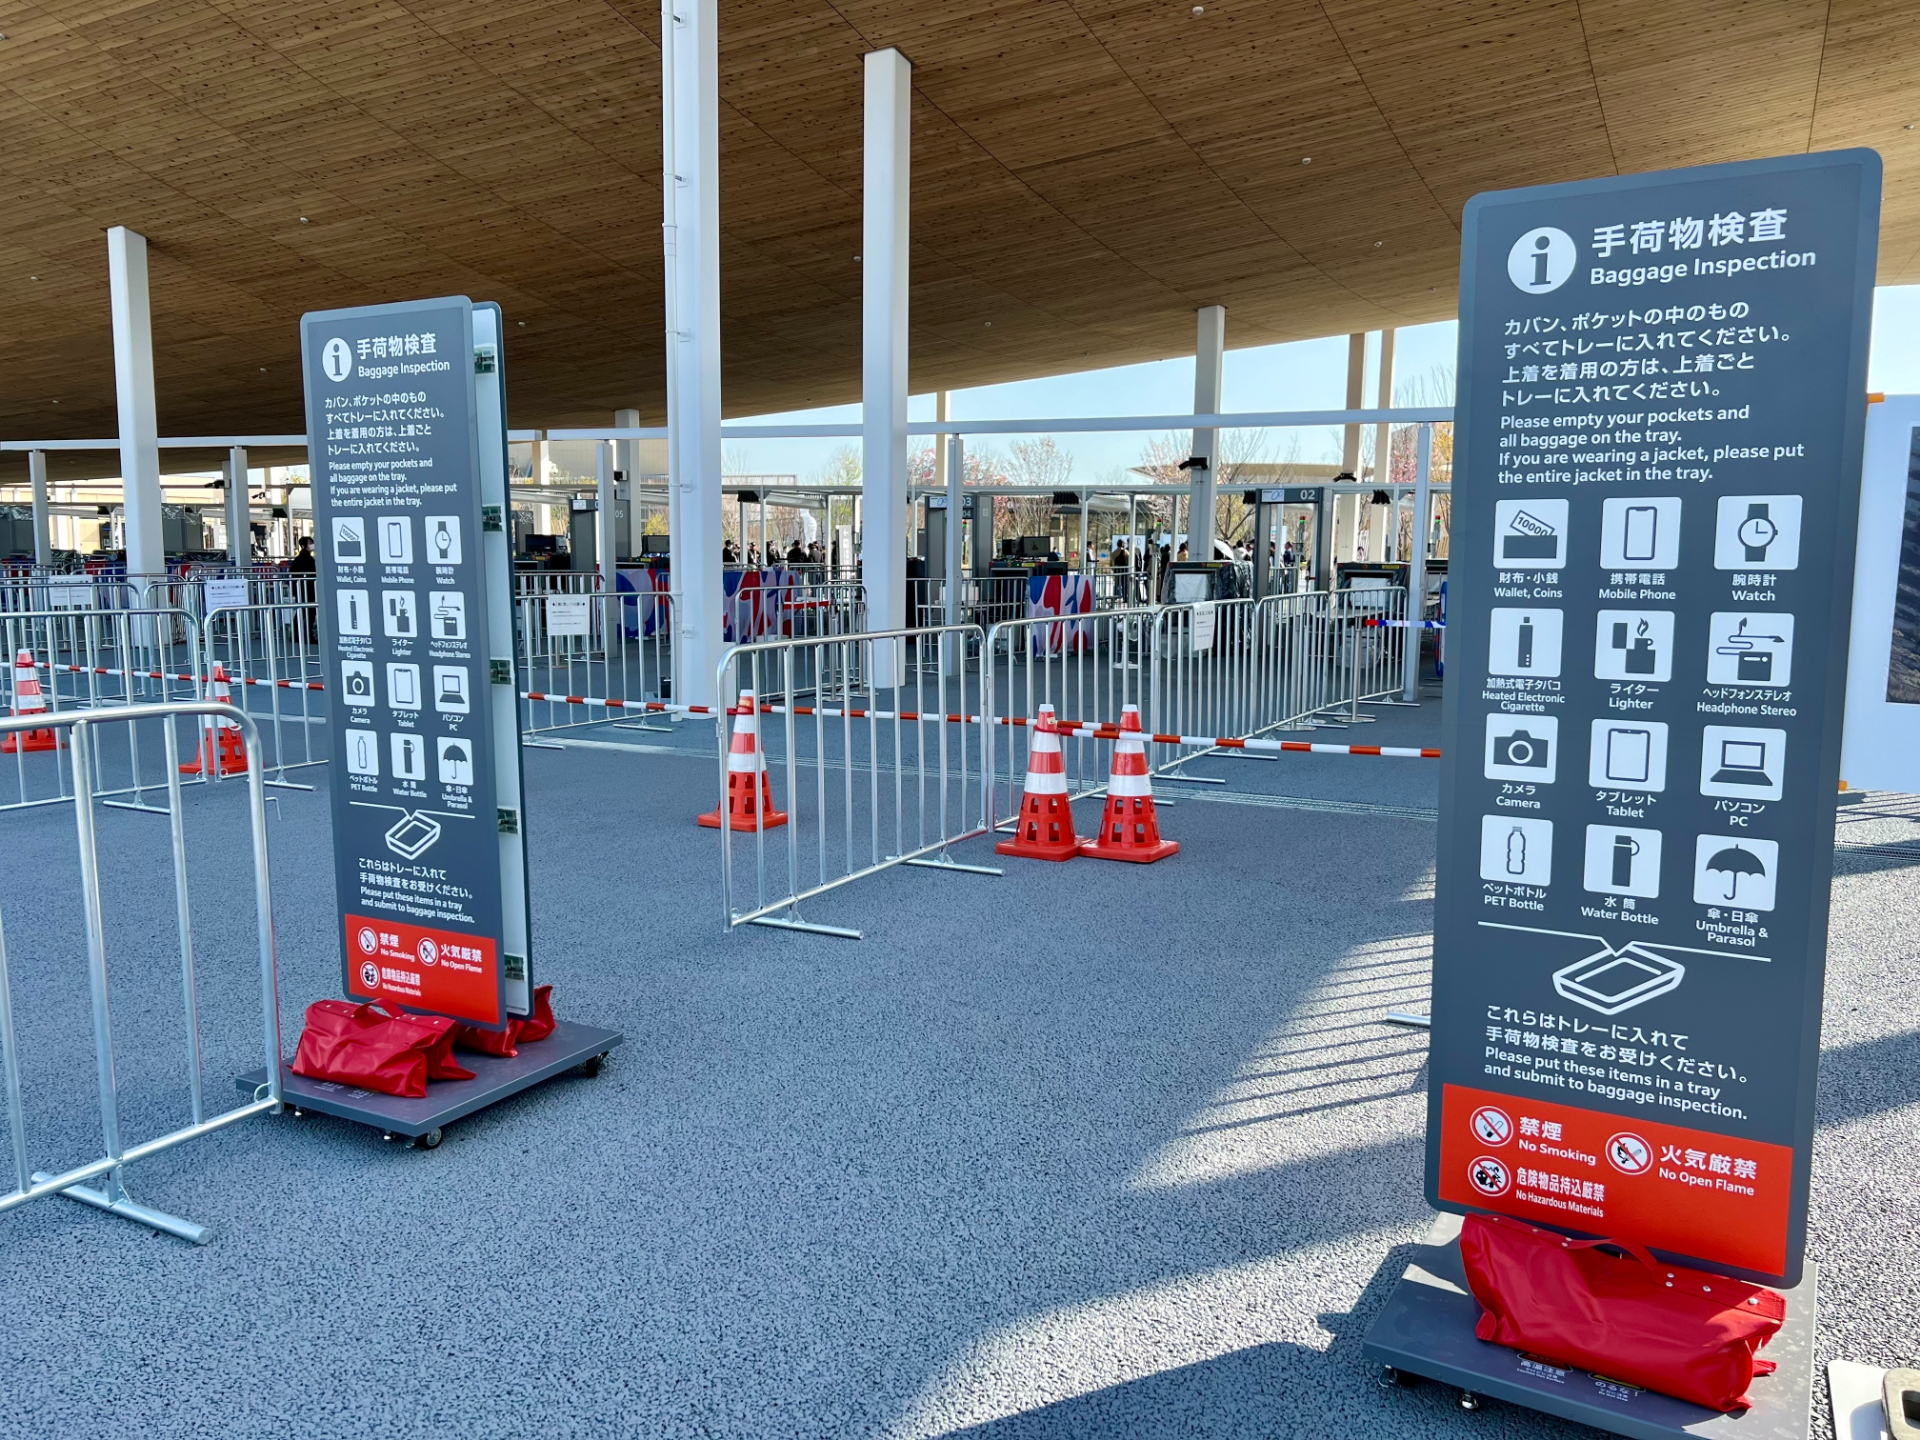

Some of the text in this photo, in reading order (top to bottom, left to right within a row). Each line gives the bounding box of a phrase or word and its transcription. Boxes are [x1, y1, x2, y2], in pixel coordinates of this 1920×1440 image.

[1592, 208, 1787, 257] 手荷物検査
[1591, 250, 1816, 286] Baggage Inspection
[1504, 326, 1789, 359] すべてトレーに入れてください。
[358, 359, 450, 379] Baggage Inspection
[1503, 381, 1719, 406] トレーに入れてください。
[1501, 405, 1749, 429] Please empty your pockets and
[1500, 429, 1682, 449] all baggage on the tray.
[1499, 444, 1804, 468] If you are wearing a jacket, please put
[329, 458, 433, 471] Please empty your pockets and
[330, 473, 338, 482] all
[338, 473, 368, 484] baggage
[378, 472, 390, 481] the
[391, 472, 407, 483] tray.
[1498, 466, 1713, 485] the entire jacket in the tray.
[330, 486, 335, 494] If
[336, 488, 349, 496] you
[362, 485, 389, 495] wearing
[395, 484, 419, 495] jacket,
[420, 483, 443, 494] please
[444, 483, 457, 494] put
[1300, 490, 1315, 500] 02
[331, 496, 422, 508] the entire jacket in the tray.
[1610, 573, 1665, 585] 携帯電話
[1732, 574, 1776, 586] 腕時計
[1494, 587, 1562, 599] Wallet, Coins
[1599, 589, 1676, 599] Mobile Phone
[1732, 590, 1775, 601] Watch
[1486, 677, 1561, 690] 加熱式電子タバコ
[1610, 683, 1659, 695] ライター
[1482, 690, 1565, 703] Heated Electronic
[1703, 688, 1792, 702] ヘッドフォンステレオ
[1501, 701, 1545, 712] Cigarette
[1609, 697, 1653, 710] Lighter
[1697, 702, 1797, 716] Headphone Stereo
[1502, 783, 1536, 795] カメラ
[1496, 796, 1540, 809] Camera
[1596, 790, 1656, 805] タブレット
[1606, 805, 1644, 818] Tablet
[1714, 800, 1765, 814] パソコン
[1730, 816, 1748, 826] PC
[360, 886, 382, 897] Please
[383, 891, 394, 899] put
[395, 892, 414, 902] these
[414, 894, 434, 905] items
[434, 898, 441, 907] in
[448, 900, 462, 912] tray
[1483, 883, 1546, 899] ペットボトル
[361, 898, 475, 923] and submit to baggage inspection.
[1484, 895, 1544, 911] PET Bottle
[1581, 906, 1658, 925] Water Bottle
[1696, 920, 1768, 938] Umbrella &
[1707, 932, 1755, 947] Parasol
[1488, 1005, 1688, 1050] これらはトレーに入れて
[1486, 1026, 1747, 1083] 手荷物検査をお受けください。
[1486, 1046, 1720, 1100] Please put these items in a tray
[1484, 1064, 1747, 1120] and submit to baggage inspection.
[1520, 1117, 1562, 1141] 禁煙
[1519, 1139, 1596, 1166] No Smoking
[1660, 1145, 1756, 1179] 火気厳禁
[1517, 1167, 1604, 1202] 危険物品持込厳禁
[1659, 1167, 1754, 1196] No Open Flame
[1516, 1189, 1604, 1218] No Hazardous Materials
